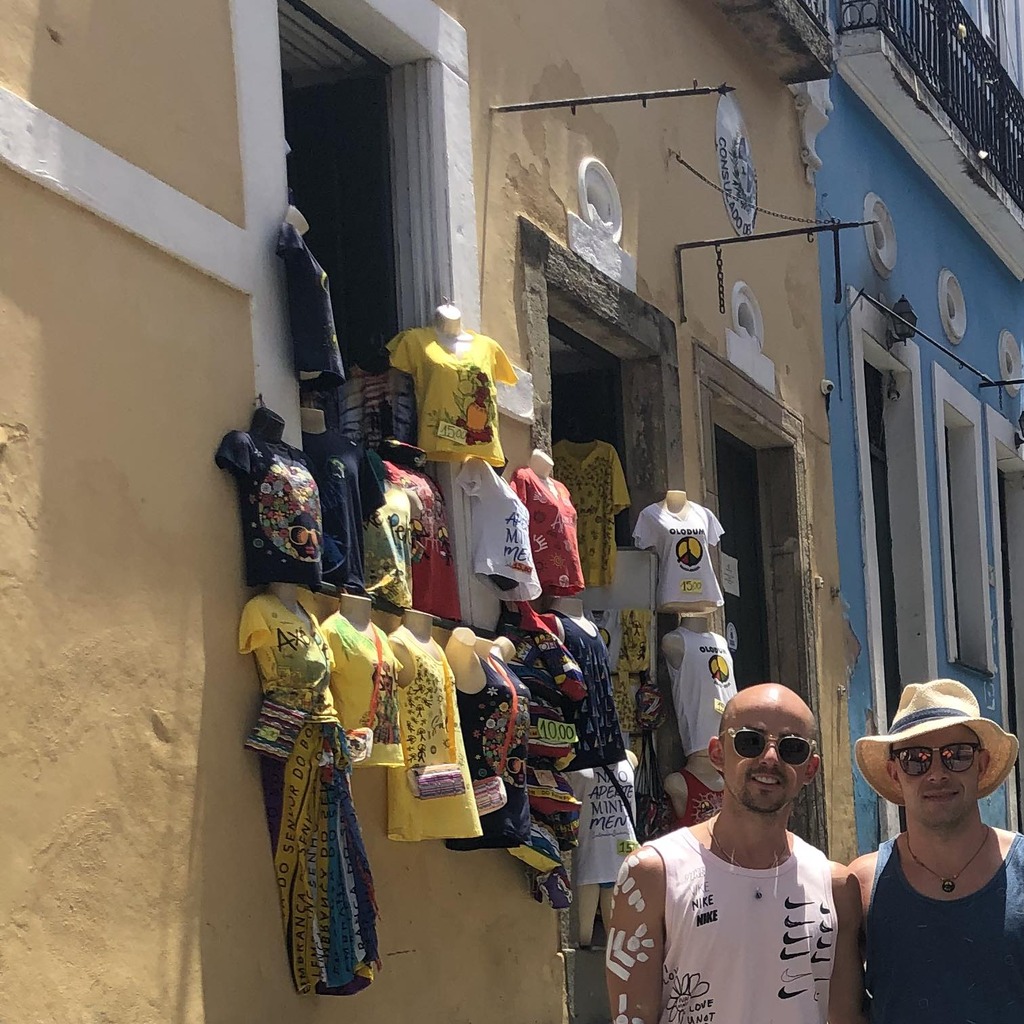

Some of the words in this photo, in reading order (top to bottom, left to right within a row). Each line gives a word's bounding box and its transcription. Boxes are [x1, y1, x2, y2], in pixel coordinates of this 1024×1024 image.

[669, 528, 706, 536] OLODUM
[540, 720, 575, 741] 10,00
[292, 755, 307, 780] DO
[597, 767, 628, 784] NO
[587, 784, 634, 800] APETE
[589, 816, 629, 831] MEN
[692, 894, 714, 912] NIKE
[696, 909, 719, 928] NIKE
[689, 999, 714, 1012] LOVE
